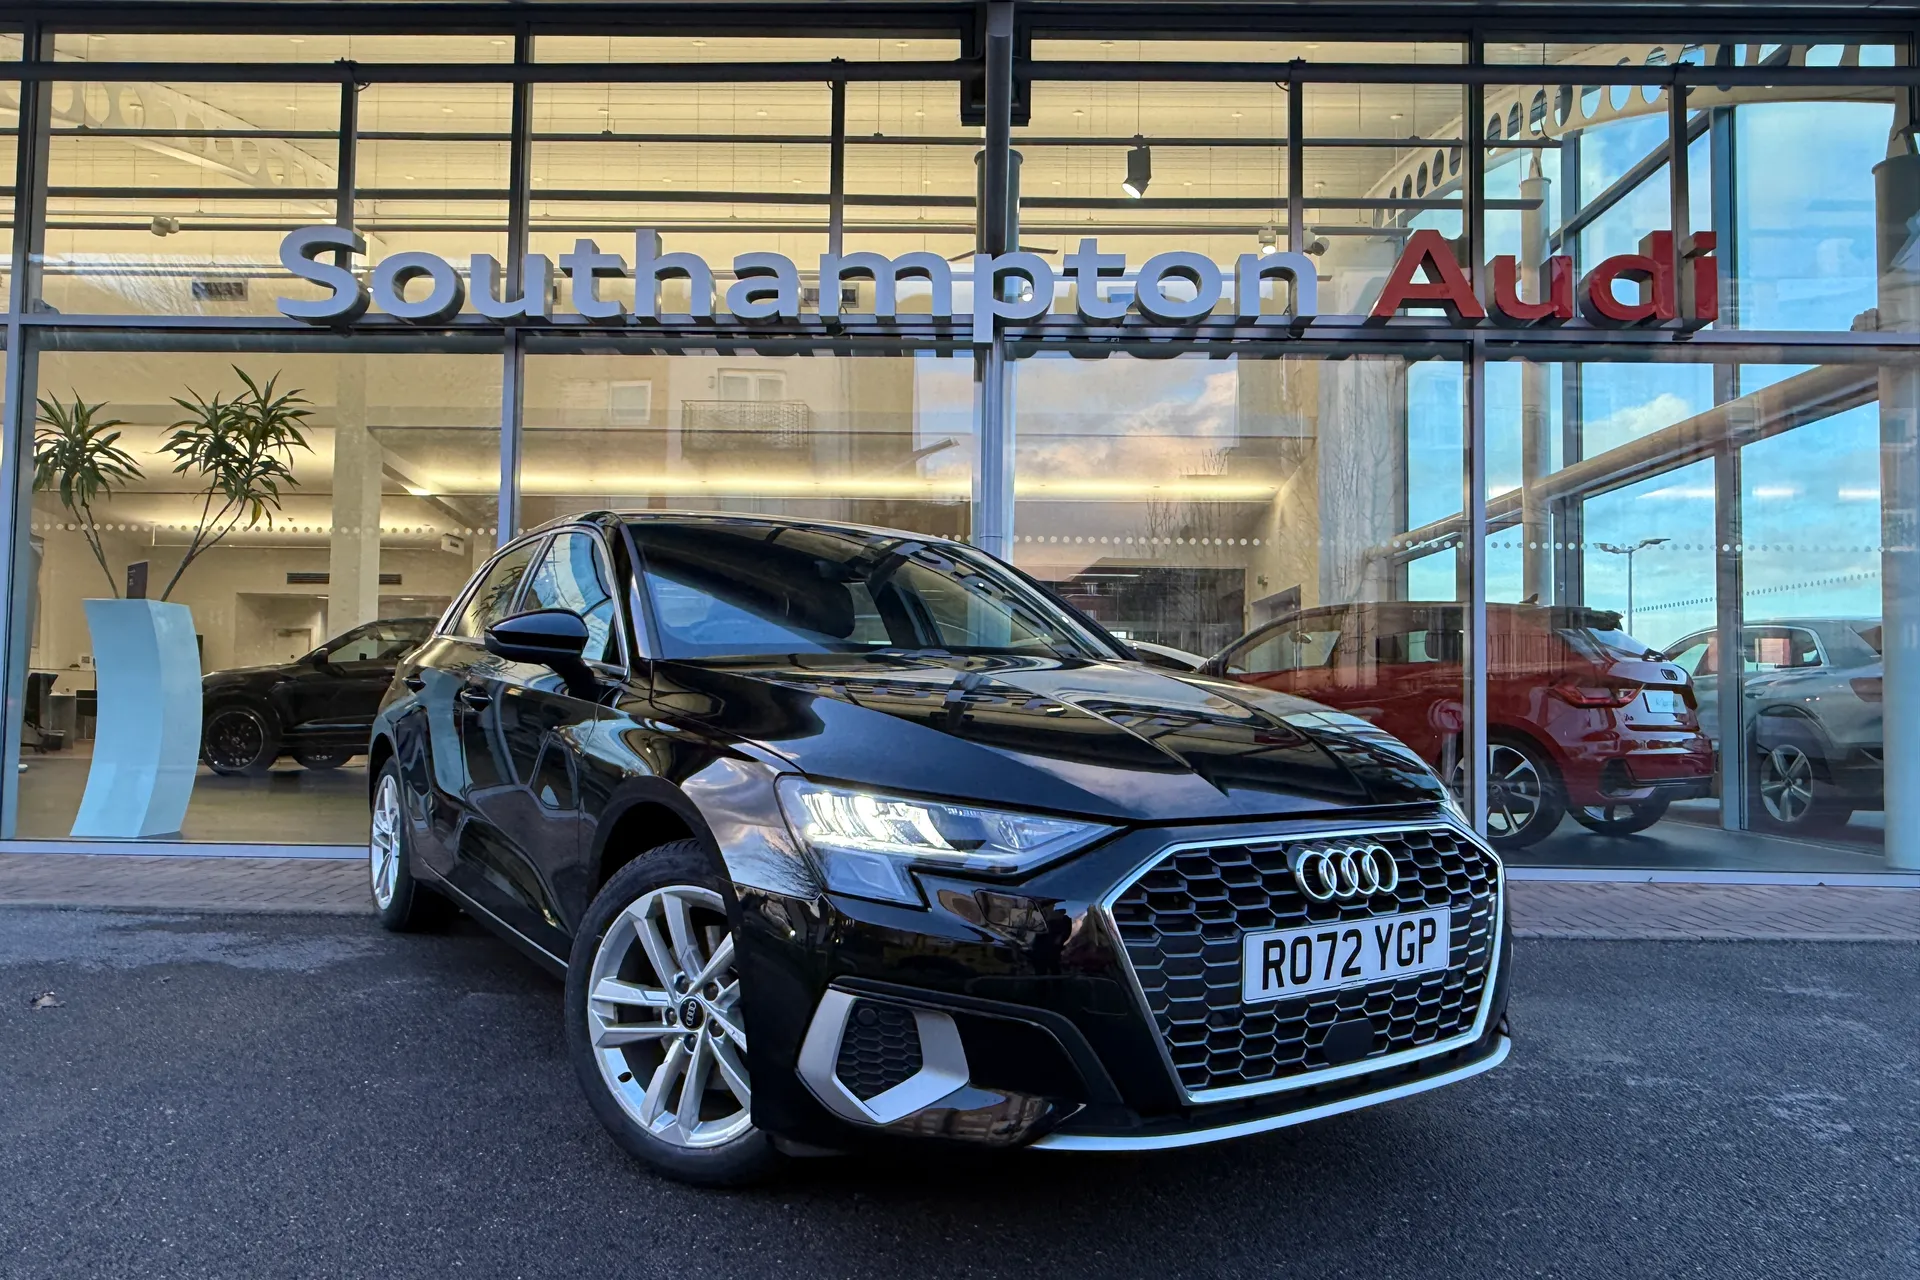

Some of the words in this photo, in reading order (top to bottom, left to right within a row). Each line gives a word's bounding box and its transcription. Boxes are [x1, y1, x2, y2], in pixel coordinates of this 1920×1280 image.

[277, 226, 1318, 343] Southampton
[1367, 229, 1719, 325] Audi
[1262, 928, 1363, 991] RO72
[1374, 917, 1437, 971] YGP
